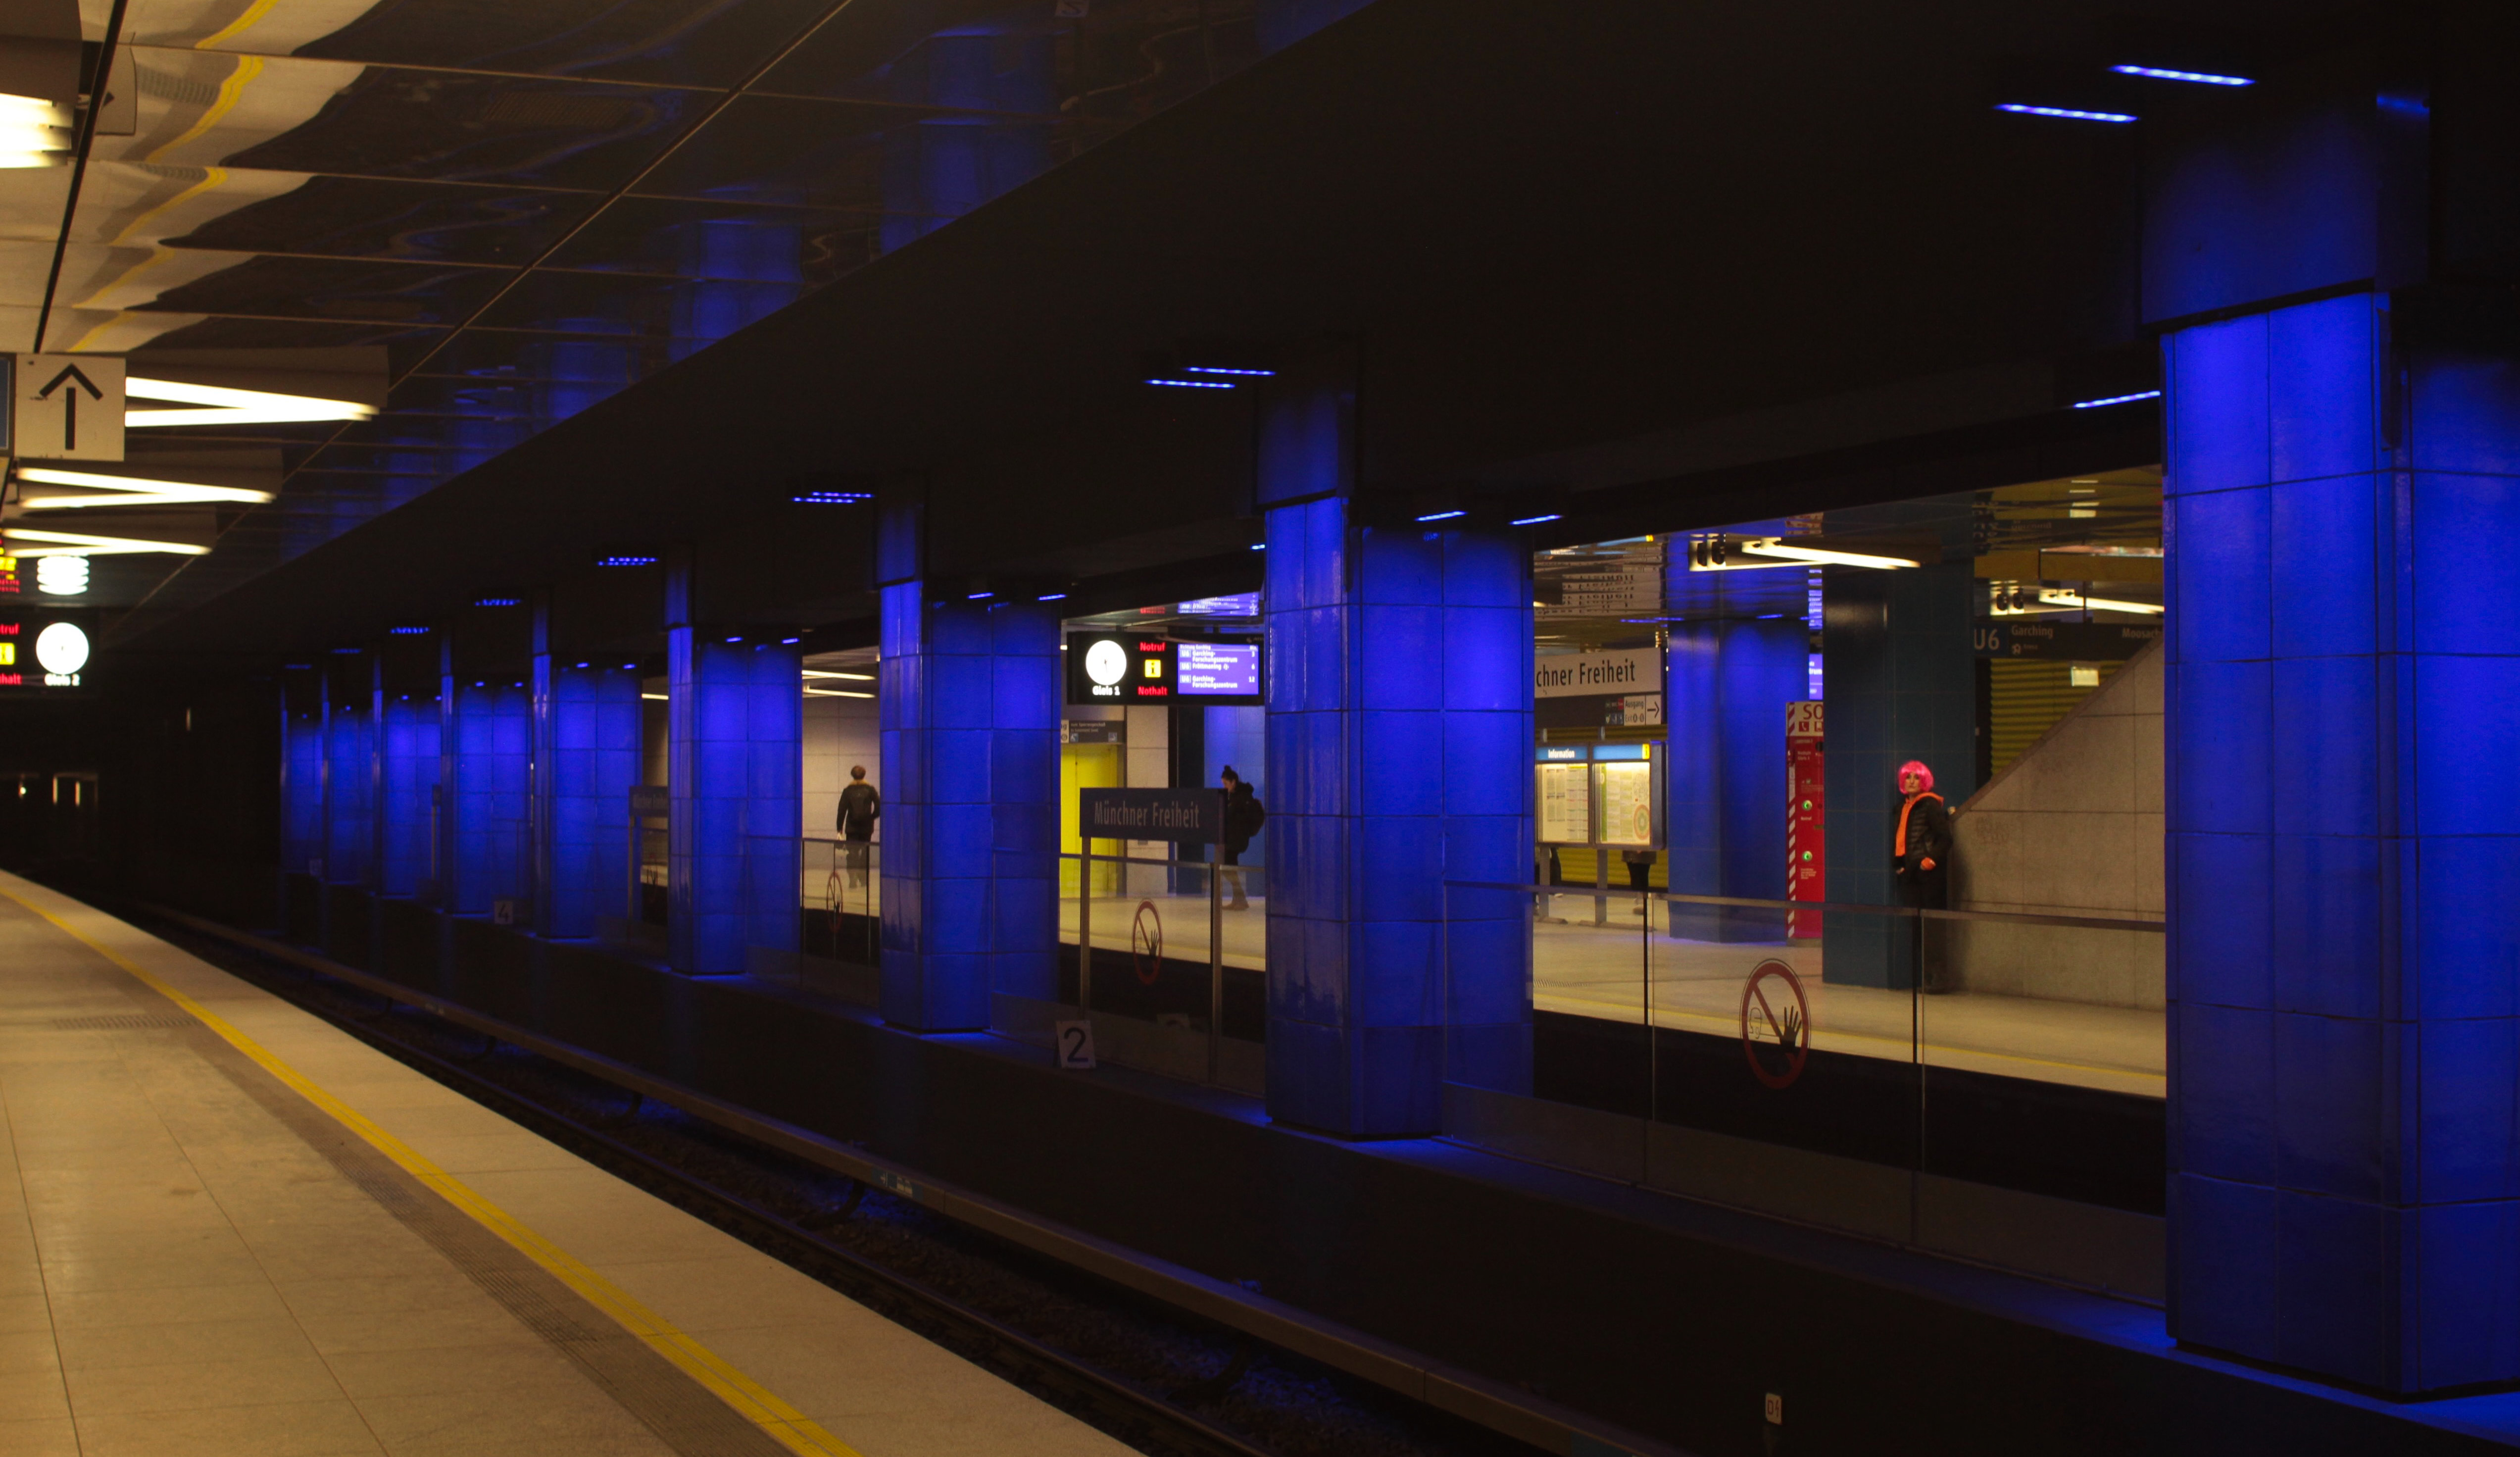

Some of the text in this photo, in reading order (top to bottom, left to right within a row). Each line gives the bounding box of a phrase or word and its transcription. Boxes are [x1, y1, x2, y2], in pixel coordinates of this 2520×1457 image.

[1974, 628, 2000, 651] U6
[2012, 624, 2054, 640] Garching
[1139, 642, 1166, 651] Notruf
[1580, 658, 1635, 684] Freiheit
[1092, 685, 1113, 696] Gleis
[1137, 685, 1168, 696] Nothalt
[1626, 699, 1644, 709] Ausgang
[1548, 748, 1575, 758] Information
[1094, 800, 1199, 829] Münchner Freiheit
[498, 904, 509, 922] 4
[1064, 1027, 1088, 1062] 2
